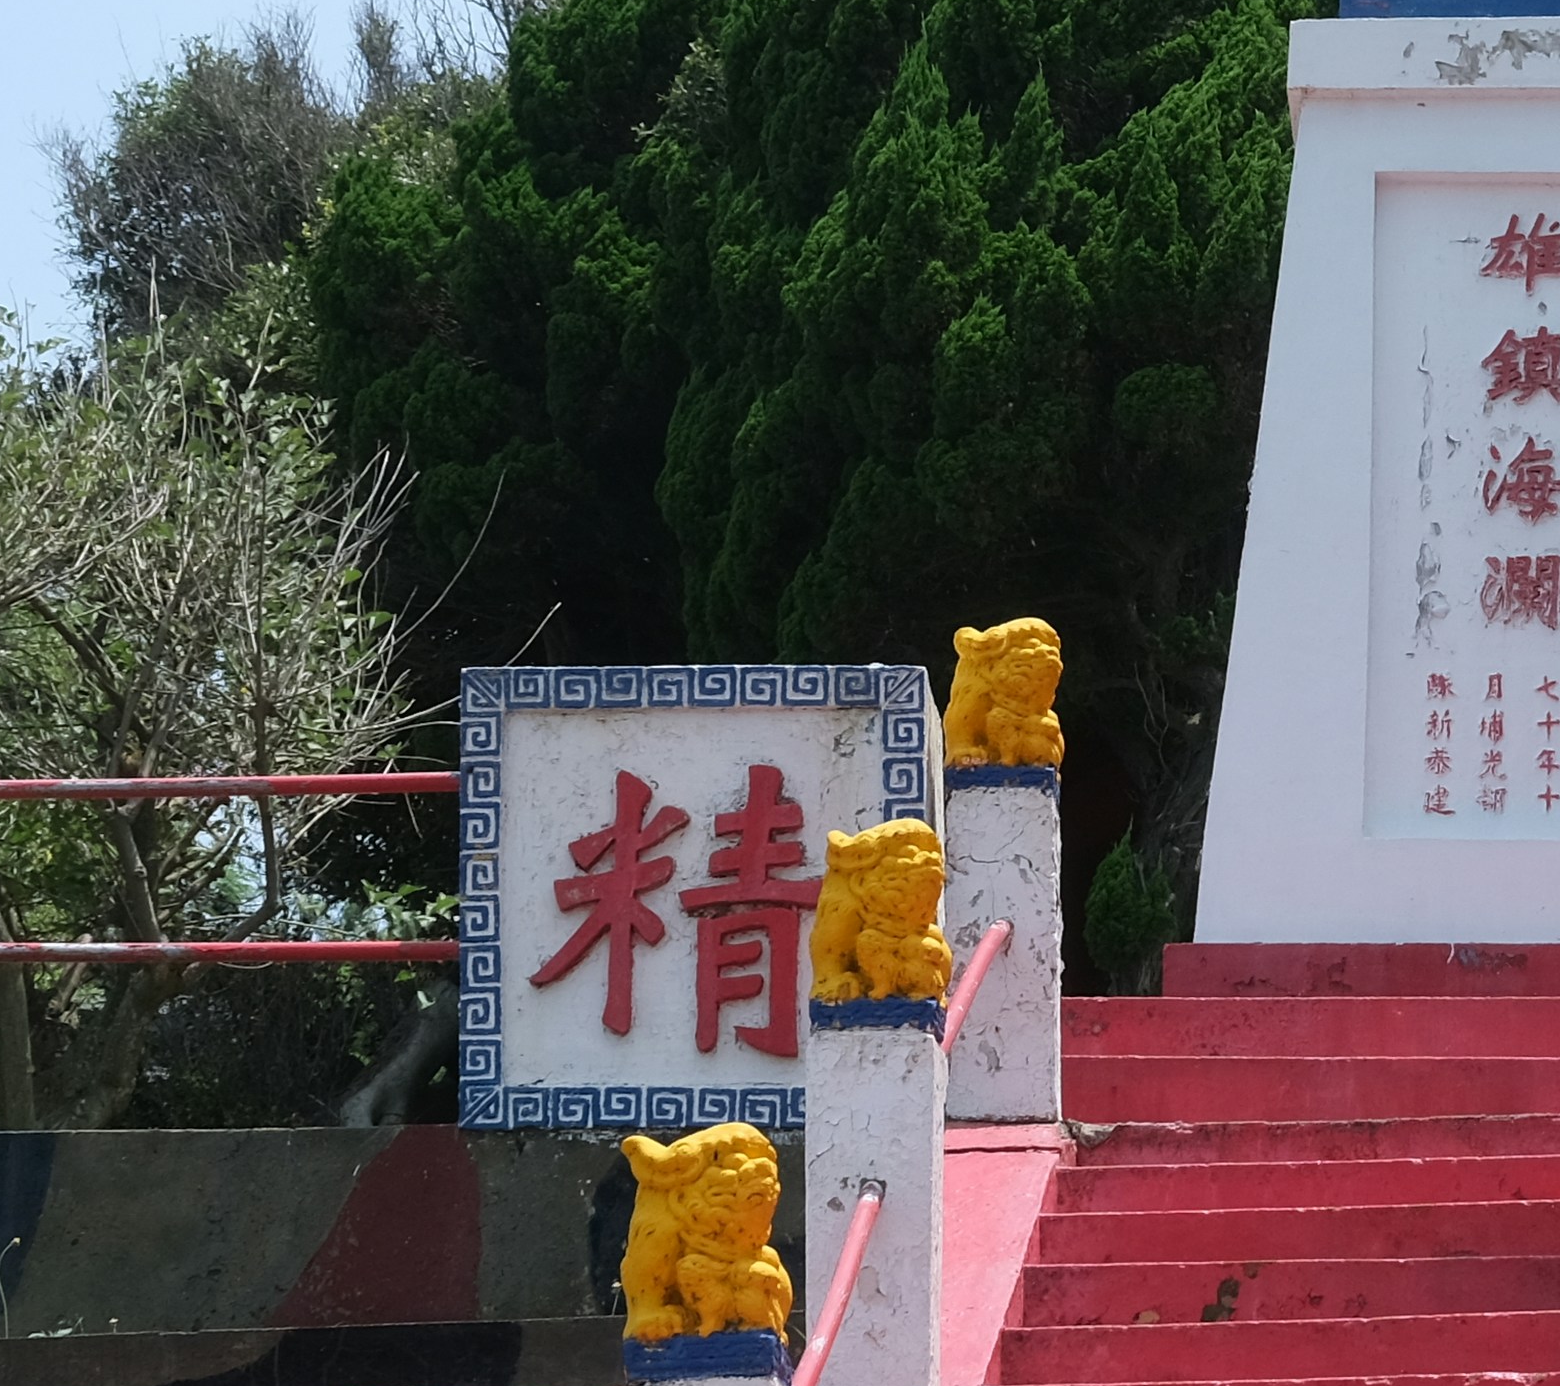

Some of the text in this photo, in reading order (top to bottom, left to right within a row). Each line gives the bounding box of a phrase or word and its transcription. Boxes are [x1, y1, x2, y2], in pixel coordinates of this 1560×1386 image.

[1535, 675, 1560, 813] 七十年十
[529, 764, 824, 1058] 精
